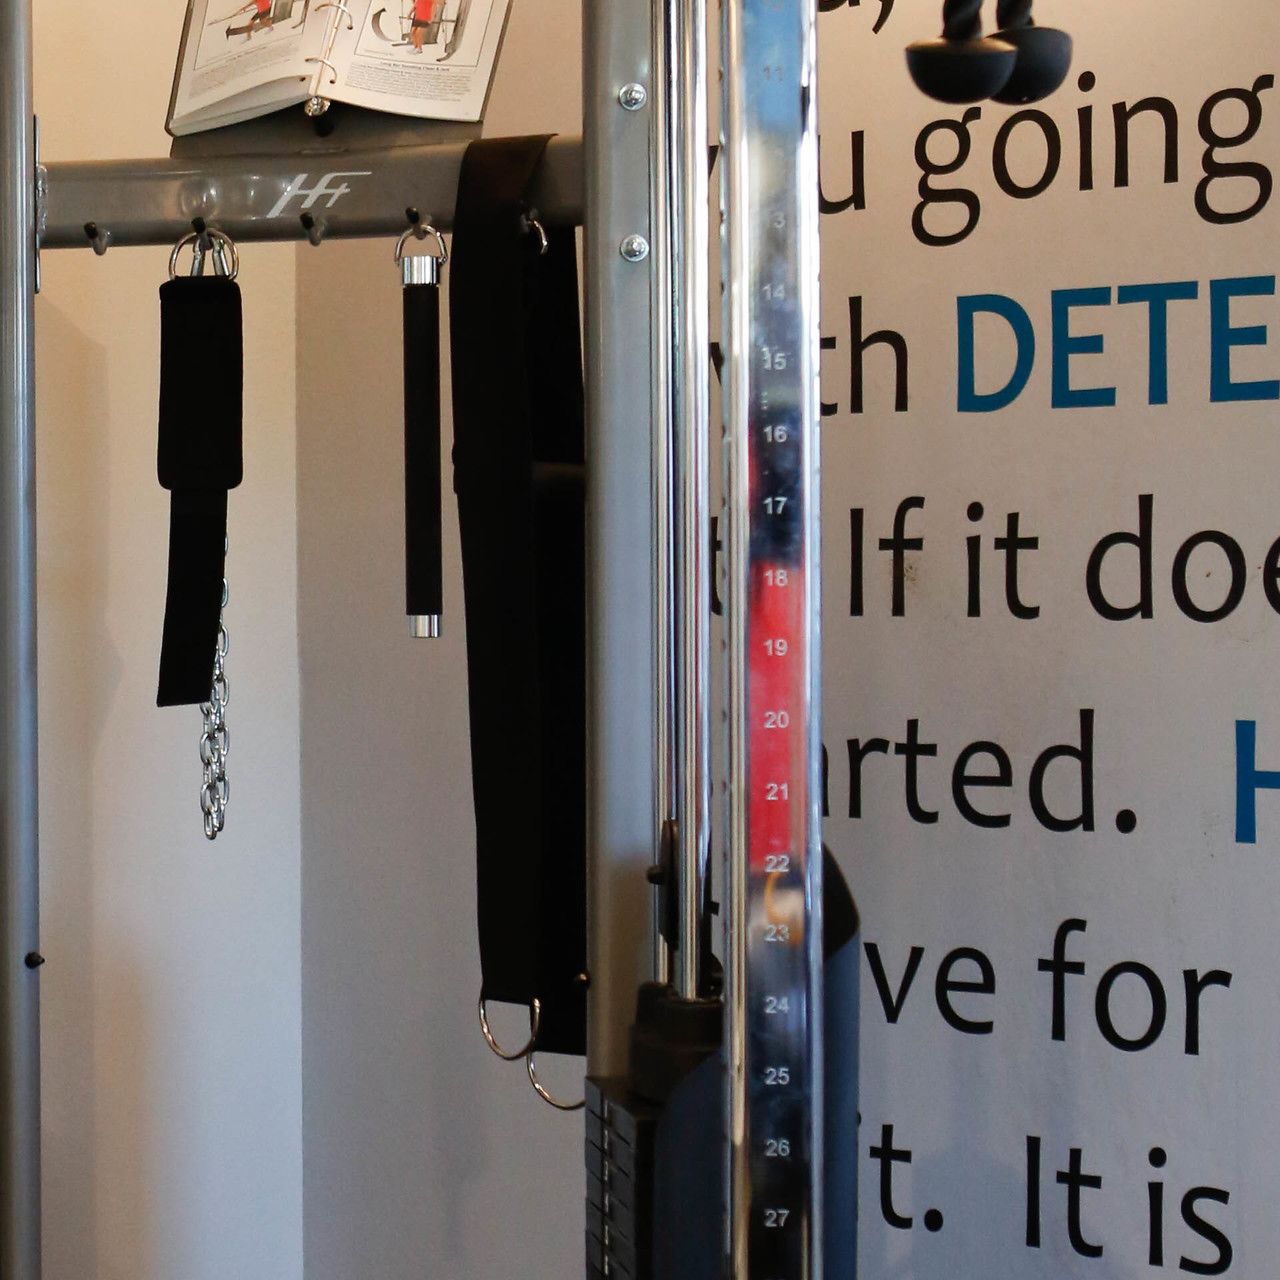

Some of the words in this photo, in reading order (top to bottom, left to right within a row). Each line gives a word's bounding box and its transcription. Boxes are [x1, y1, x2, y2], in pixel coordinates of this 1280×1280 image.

[912, 71, 1275, 248] going
[957, 275, 1280, 413] DETE
[763, 425, 787, 443] 16
[763, 497, 787, 515] 17
[850, 496, 925, 618] If
[966, 501, 1040, 621] it
[1086, 494, 1280, 624] do
[763, 569, 788, 587] 18
[763, 639, 788, 656] 19
[764, 711, 789, 729] 20
[821, 708, 1137, 835] rted.
[766, 783, 789, 801] 21
[764, 855, 789, 873] 22
[764, 924, 789, 942] 23
[863, 942, 996, 1036] ve
[1038, 918, 1233, 1056] for
[764, 996, 790, 1014] 24
[764, 1068, 790, 1086] 25
[764, 1139, 790, 1157] 26
[869, 1124, 944, 1233] t.
[1026, 1135, 1104, 1260] It
[1148, 1147, 1233, 1277] is
[764, 1210, 790, 1228] 27
